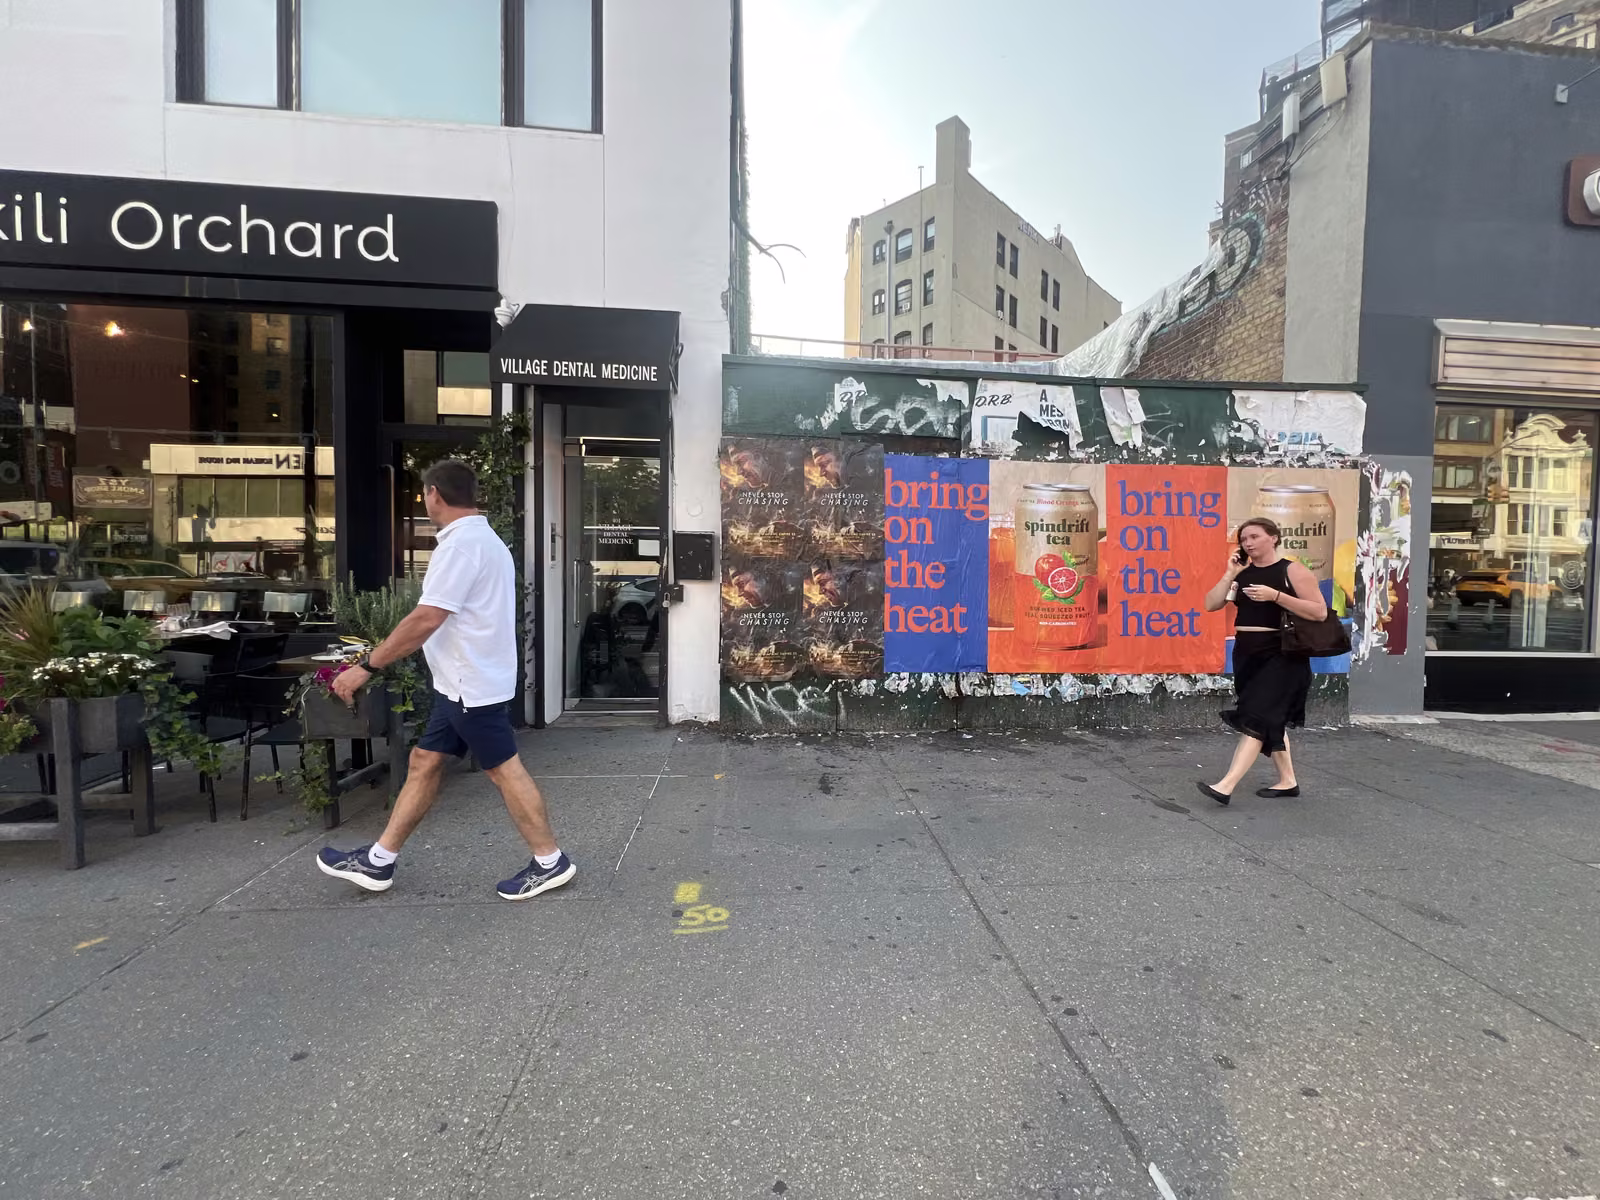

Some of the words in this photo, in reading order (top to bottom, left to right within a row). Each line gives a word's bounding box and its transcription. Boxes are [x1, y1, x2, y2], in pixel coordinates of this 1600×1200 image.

[110, 200, 400, 263] Orchard
[500, 358, 548, 376] VILLAGE
[553, 360, 597, 378] DENTAL
[601, 363, 658, 381] MEDICINE
[884, 468, 990, 521] bring
[1118, 479, 1221, 528] bring
[884, 516, 934, 545] on
[1024, 518, 1090, 536] spindrift
[1046, 534, 1071, 545] tea
[1119, 525, 1170, 551] on
[1283, 538, 1308, 549] tea
[884, 549, 946, 590] the
[1119, 557, 1181, 594] the
[739, 618, 790, 626] CHASING
[884, 592, 968, 634] heat
[1119, 600, 1202, 637] heat
